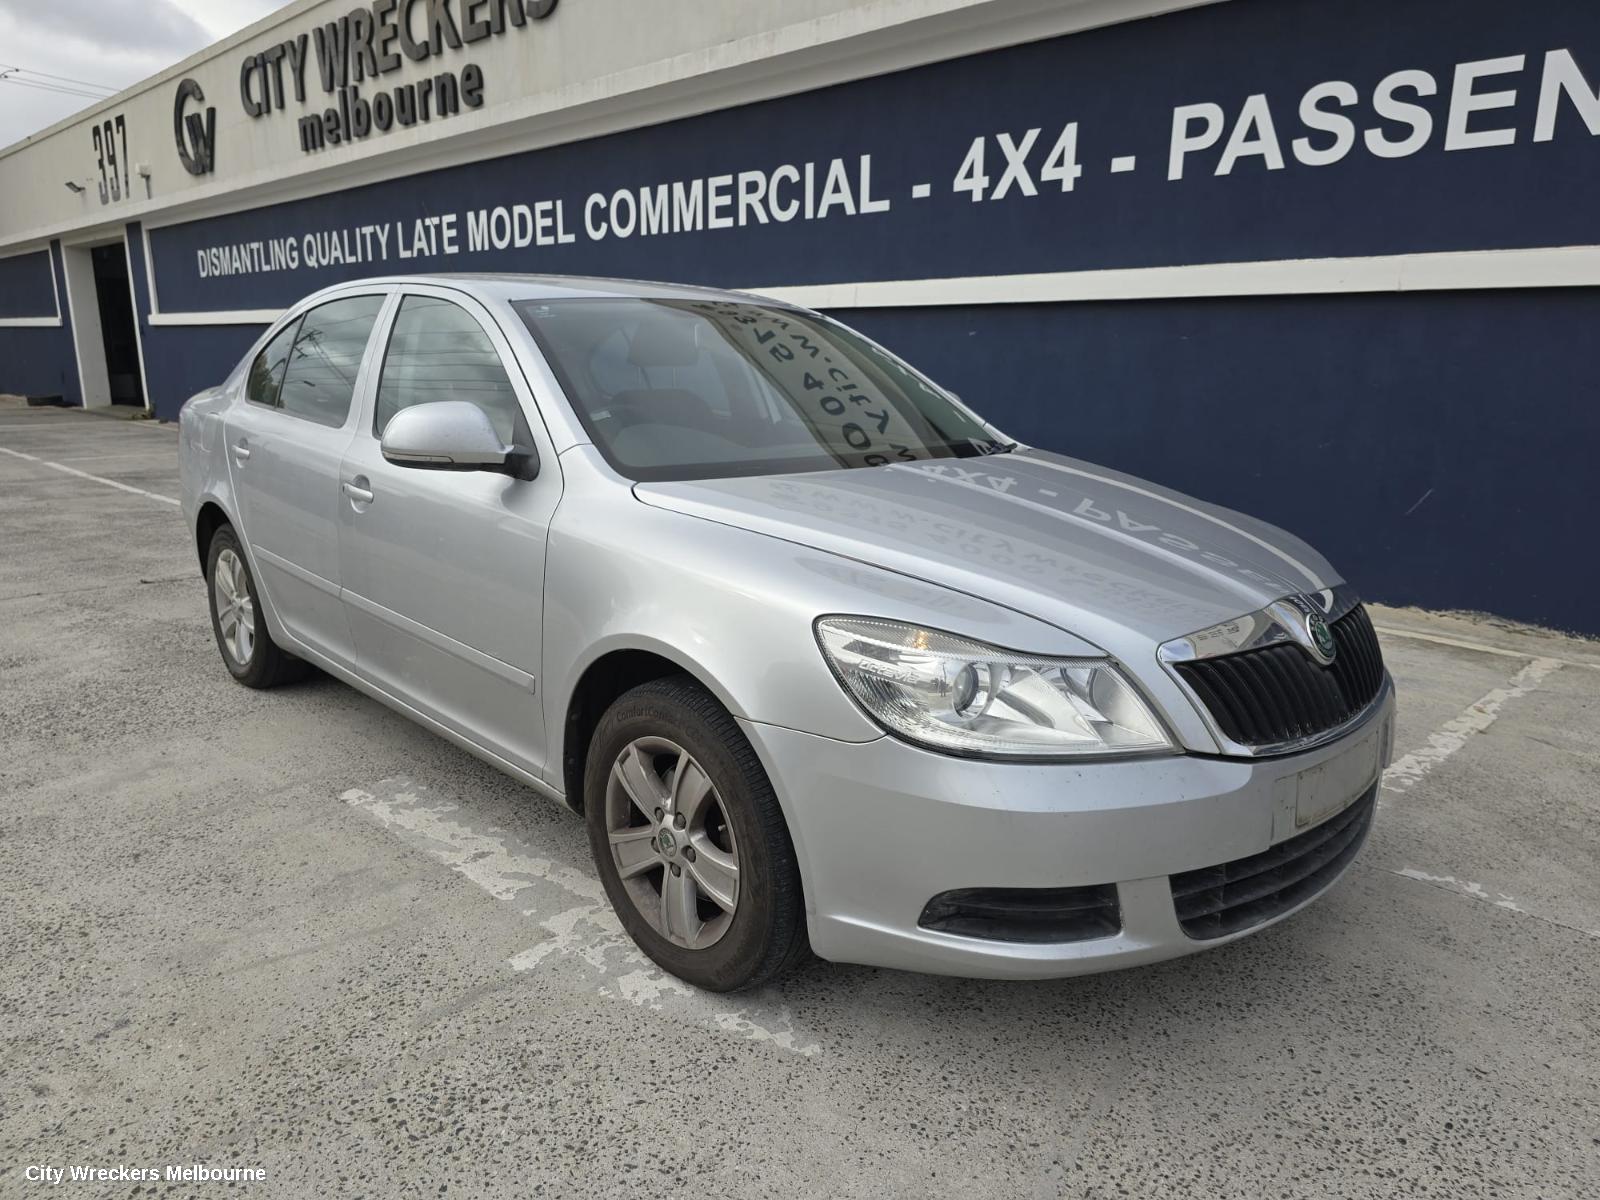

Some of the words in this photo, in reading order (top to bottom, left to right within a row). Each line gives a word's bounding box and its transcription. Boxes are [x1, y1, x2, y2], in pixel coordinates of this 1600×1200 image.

[240, 34, 308, 118] CITY
[312, 0, 559, 92] WRECKE
[298, 63, 484, 152] melbourne
[92, 114, 130, 206] 397
[197, 236, 299, 278] DISMANTLING
[303, 223, 390, 268] QUALITY
[397, 213, 459, 258] LATE
[467, 200, 576, 252] MODEL
[584, 154, 890, 241] COMMERCIAL
[952, 121, 1082, 202] 4X4
[1167, 48, 1600, 181] PASSEN
